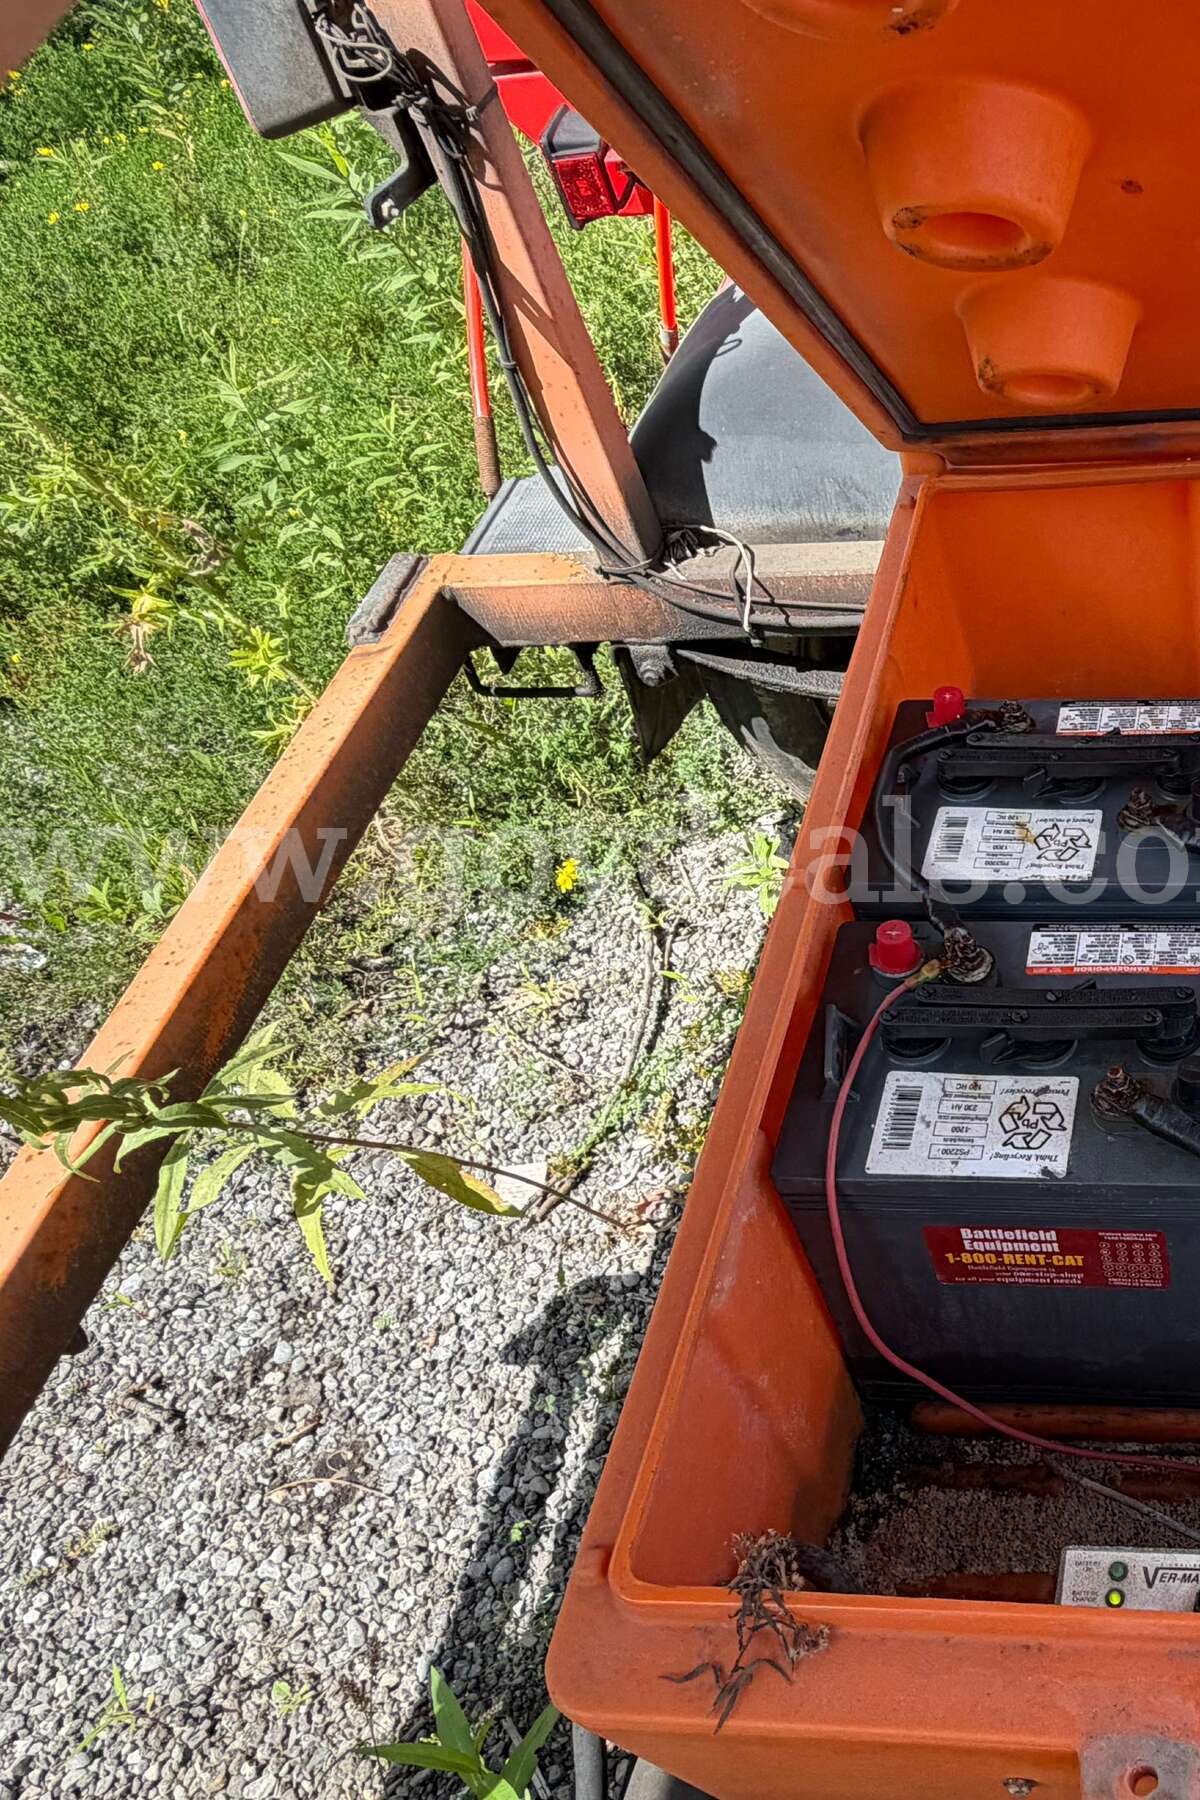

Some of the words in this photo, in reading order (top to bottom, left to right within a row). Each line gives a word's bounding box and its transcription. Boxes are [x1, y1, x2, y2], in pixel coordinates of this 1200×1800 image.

[1053, 839, 1068, 847] Pb
[1022, 1118, 1039, 1129] Pb
[989, 1151, 1032, 1162] Recycling!
[1035, 1154, 1058, 1162] Think
[960, 1228, 1057, 1241] Battlefield
[963, 1240, 1060, 1252] Equipment
[945, 1252, 1084, 1266] 1-800-RENT-CAT
